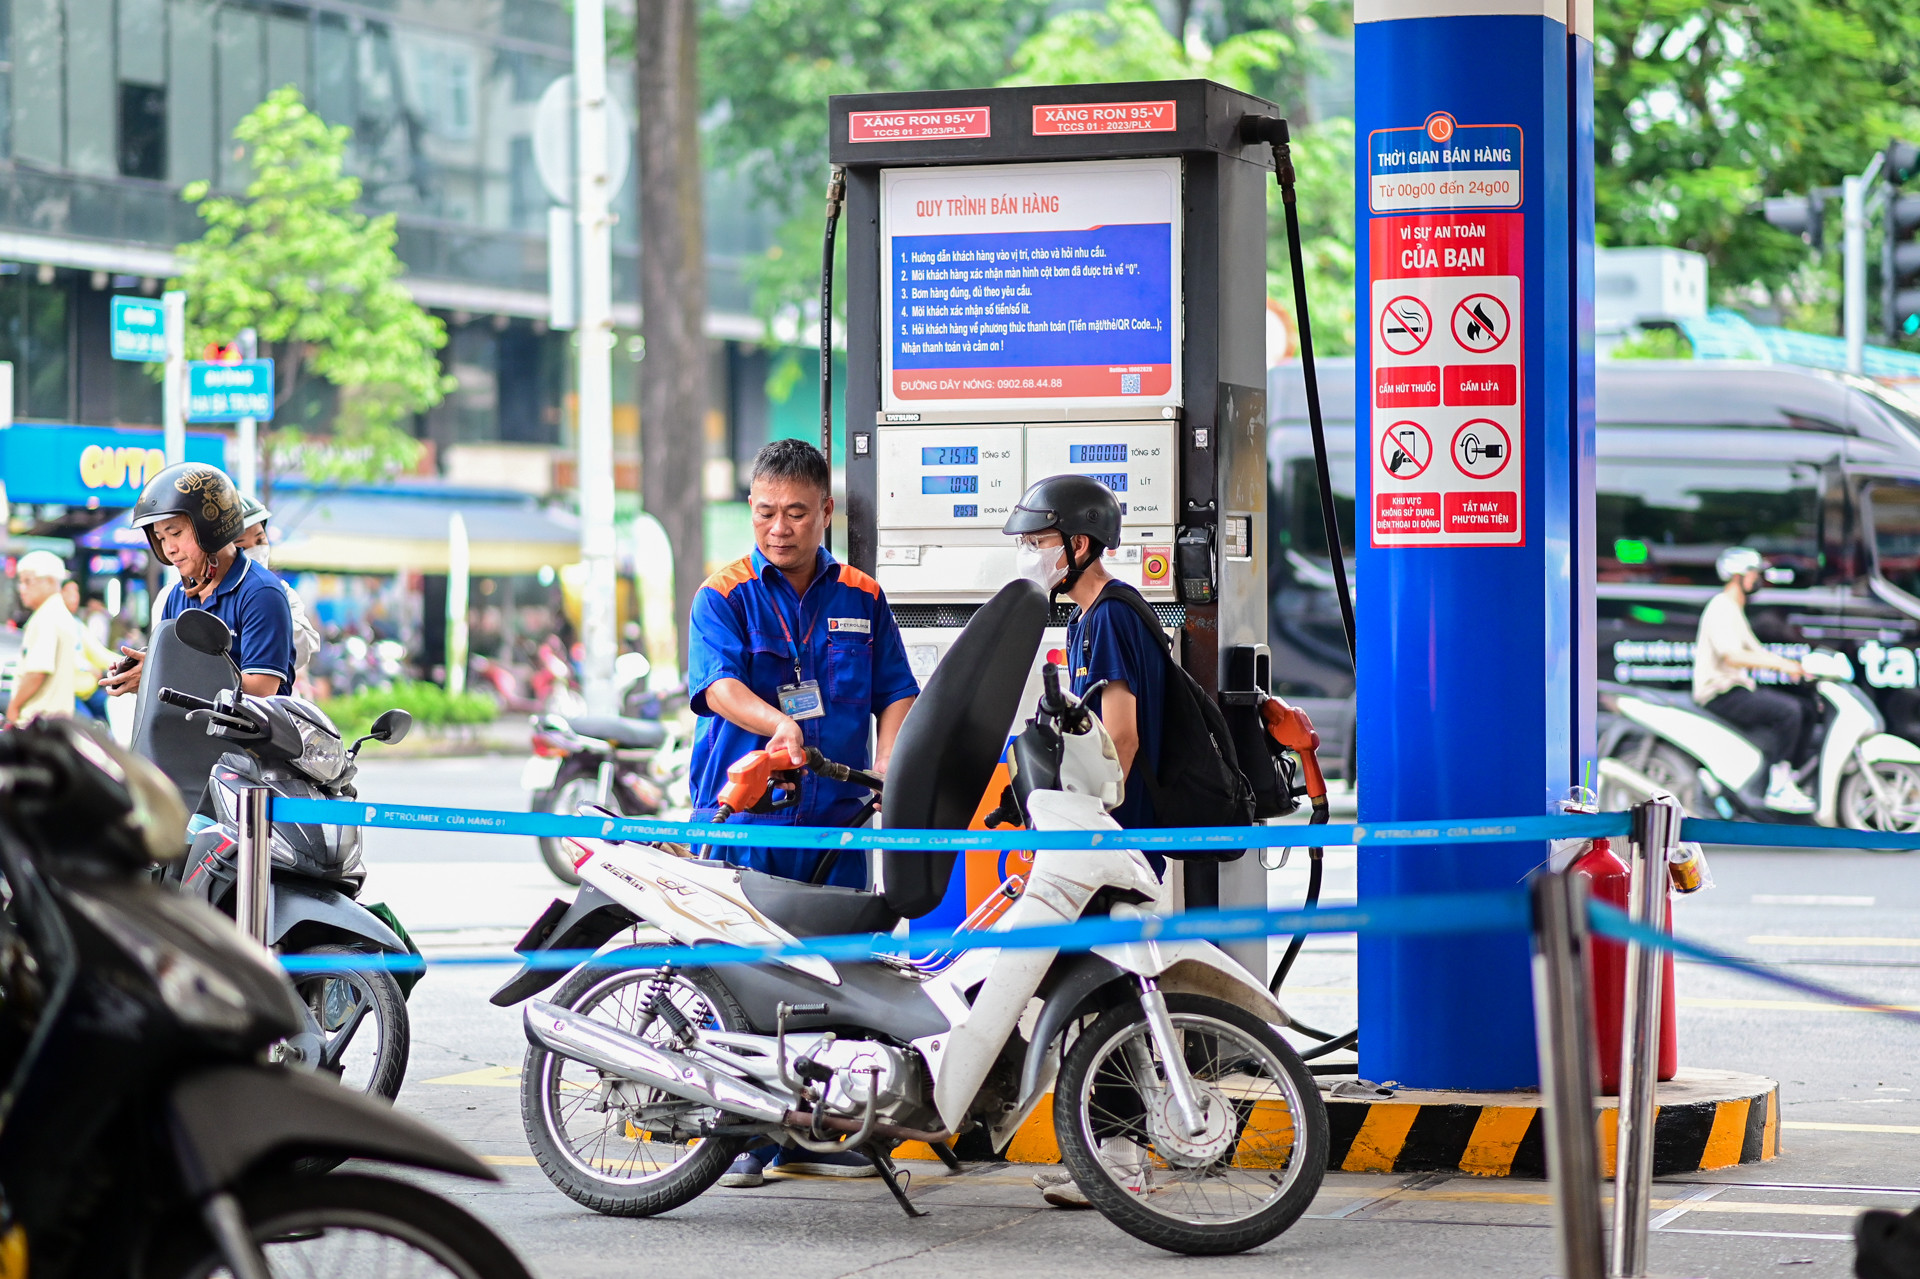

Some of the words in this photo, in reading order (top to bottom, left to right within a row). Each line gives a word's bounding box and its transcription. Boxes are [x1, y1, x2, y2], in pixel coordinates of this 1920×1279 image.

[863, 114, 906, 127] XĂNG
[909, 115, 942, 126] RON
[944, 114, 975, 124] 95-V
[1045, 108, 1088, 122] XĂNG
[1093, 109, 1127, 120] RON
[1131, 107, 1163, 119] 95-V
[873, 129, 900, 137] TCCS
[902, 128, 913, 136] 01
[922, 127, 966, 135] 2023/PLX
[1057, 123, 1084, 132] TCCS
[1087, 122, 1098, 131] 01
[1107, 120, 1151, 130] 2023/PLX
[1378, 150, 1405, 167] THỜI
[1409, 151, 1439, 165] GIAN
[1443, 147, 1470, 163] BÁN
[1474, 147, 1511, 162] HÀNG
[1379, 185, 1395, 198] Từ
[1398, 183, 1436, 198] 00g00
[1440, 180, 1464, 194] đến
[1469, 181, 1510, 196] 24g00
[916, 200, 943, 217] QUY
[946, 195, 986, 217] TRÌNH
[991, 194, 1017, 215] BÁN
[1022, 193, 1059, 214] HÀNG
[1400, 225, 1411, 240] VÌ
[1414, 226, 1432, 241] SỰ
[1434, 226, 1450, 238] AN
[1454, 222, 1486, 237] TOÀN
[901, 252, 908, 263] 1.
[937, 249, 951, 263] dẫn
[952, 250, 974, 262] khách
[976, 249, 994, 263] hàng
[996, 249, 1010, 260] vào
[1011, 249, 1018, 262] vị
[1031, 248, 1049, 259] chào
[1050, 248, 1060, 259] và
[1061, 246, 1073, 258] hỏi
[1074, 247, 1089, 258] nhu
[1401, 243, 1438, 269] CỦA
[1445, 248, 1485, 271] BẠN
[901, 270, 908, 281] 2.
[926, 269, 948, 280] khách
[950, 268, 968, 282] hàng
[970, 268, 983, 279] xác
[984, 267, 1003, 281] nhận
[1005, 267, 1020, 278] màn
[1022, 266, 1039, 278] hình
[1041, 266, 1052, 280] cột
[1054, 266, 1070, 277] bơm
[1072, 265, 1081, 276] đã
[1082, 265, 1101, 278] được
[1103, 264, 1113, 276] trả
[901, 288, 908, 299] 3.
[912, 288, 928, 299] Bơm
[930, 287, 948, 301] hàng
[973, 285, 982, 298] đủ
[984, 286, 1000, 297] theo
[1001, 285, 1015, 299] yêu
[901, 306, 908, 317] 4.
[926, 305, 948, 316] khách
[950, 304, 963, 316] xác
[965, 304, 983, 318] nhận
[984, 303, 994, 315] số
[901, 324, 908, 335] 5.
[926, 323, 948, 334] khách
[950, 323, 968, 336] hàng
[980, 322, 1008, 336] phương
[1009, 321, 1026, 332] thức
[1027, 321, 1048, 332] thanh
[1050, 320, 1066, 332] toán
[902, 342, 920, 355] Nhận
[922, 342, 943, 352] thanh
[945, 341, 961, 352] toán
[962, 341, 971, 352] và
[973, 340, 988, 351] cảm
[990, 342, 999, 351] ơn
[901, 380, 937, 391] ĐƯỜNG
[940, 379, 960, 390] DÂY
[997, 378, 1062, 389] 0902.68.44.88
[1379, 381, 1394, 394] CẤM
[1396, 382, 1410, 393] HÚT
[1411, 380, 1436, 393] THUỐC
[1460, 380, 1479, 392] CẤM
[1481, 380, 1499, 391] LỬA
[939, 448, 976, 464] 21515
[982, 450, 999, 458] TỔNG
[1001, 450, 1010, 458] SỐ
[1081, 445, 1127, 462] 800000
[1131, 448, 1149, 456] TỔNG
[1151, 448, 1160, 456] SỐ
[1392, 497, 1405, 505] KHU
[1406, 497, 1422, 505] VỰC
[1462, 502, 1478, 512] TẮT
[1479, 502, 1498, 511] MÁY
[1382, 507, 1402, 517] KHÔNG
[1403, 507, 1414, 516] SỬ
[1416, 508, 1434, 518] DỤNG
[1452, 514, 1489, 524] PHƯƠNG
[1491, 514, 1509, 524] TIỆN
[1377, 519, 1391, 530] ĐIỆN
[1392, 520, 1411, 530] THOẠI
[1420, 519, 1440, 529] ĐỘNG
[384, 811, 439, 823] PETROLIMEX
[467, 815, 493, 826] HÀNG
[621, 824, 679, 836] PETROLIMEX
[1374, 829, 1439, 839] PETROLIMEX
